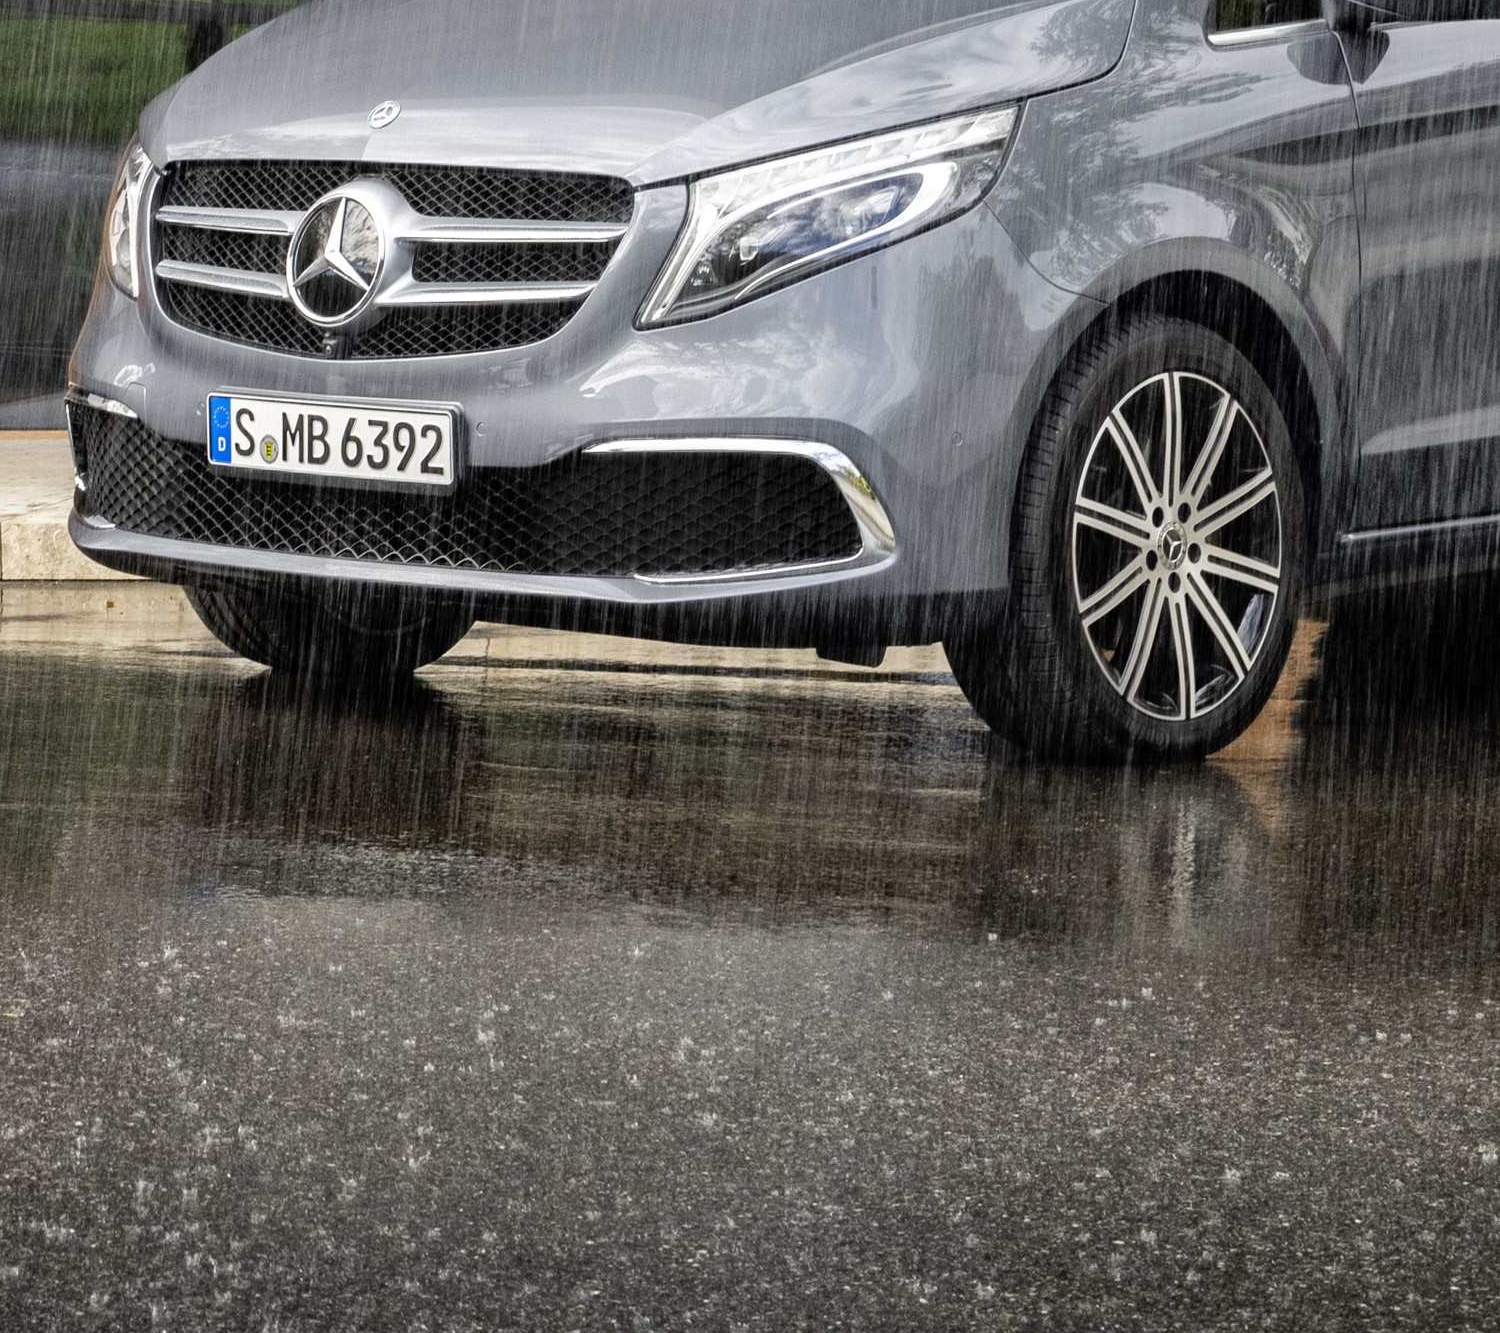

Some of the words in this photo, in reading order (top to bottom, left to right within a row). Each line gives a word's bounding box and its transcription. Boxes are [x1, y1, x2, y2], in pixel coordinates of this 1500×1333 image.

[217, 436, 227, 452] D
[235, 408, 255, 456] S
[282, 412, 331, 465] MB
[341, 417, 444, 475] 6392
